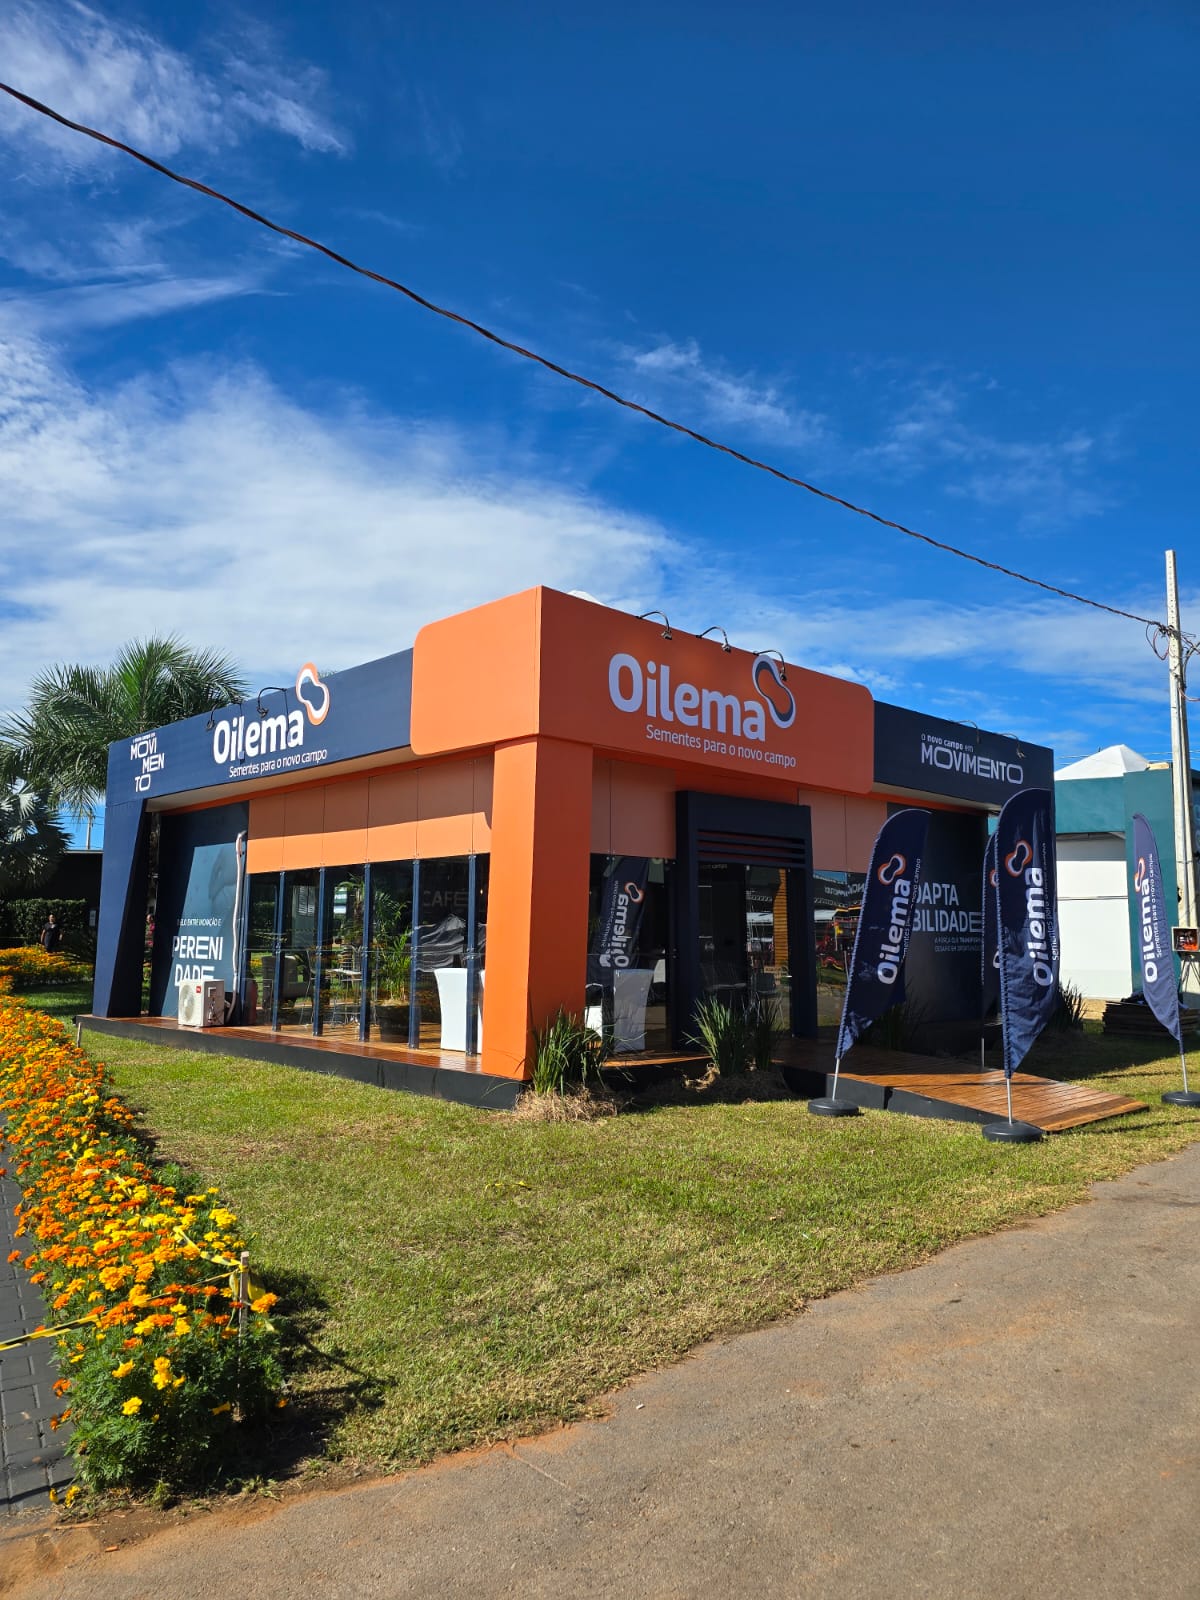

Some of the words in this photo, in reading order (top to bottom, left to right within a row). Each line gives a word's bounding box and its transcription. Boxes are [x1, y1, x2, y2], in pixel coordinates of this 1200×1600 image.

[608, 653, 765, 742] Oilema
[130, 737, 157, 760] MOVI
[213, 709, 304, 764] Oilema
[646, 724, 701, 749] Sementes
[703, 739, 727, 754] para
[729, 746, 736, 755] o
[738, 746, 762, 761] novo
[764, 751, 796, 768] campo
[927, 735, 943, 745] novo
[944, 739, 964, 750] campo
[964, 744, 974, 753] em
[142, 752, 165, 774] MEN
[229, 763, 260, 778] Sementes
[260, 759, 276, 775] para
[276, 760, 282, 769] o
[282, 756, 300, 767] novo
[301, 749, 328, 764] campo
[921, 742, 1024, 785] MOVIMENTO
[134, 774, 151, 792] TO
[916, 882, 959, 906] DAPTA
[877, 879, 911, 985] Oilema
[912, 909, 981, 932] BILIDADE
[1025, 867, 1053, 987] Oilema
[1142, 878, 1158, 983] Oilema
[172, 935, 223, 960] PERENI
[1152, 922, 1162, 958] Sementes
[174, 963, 215, 986] DADE
